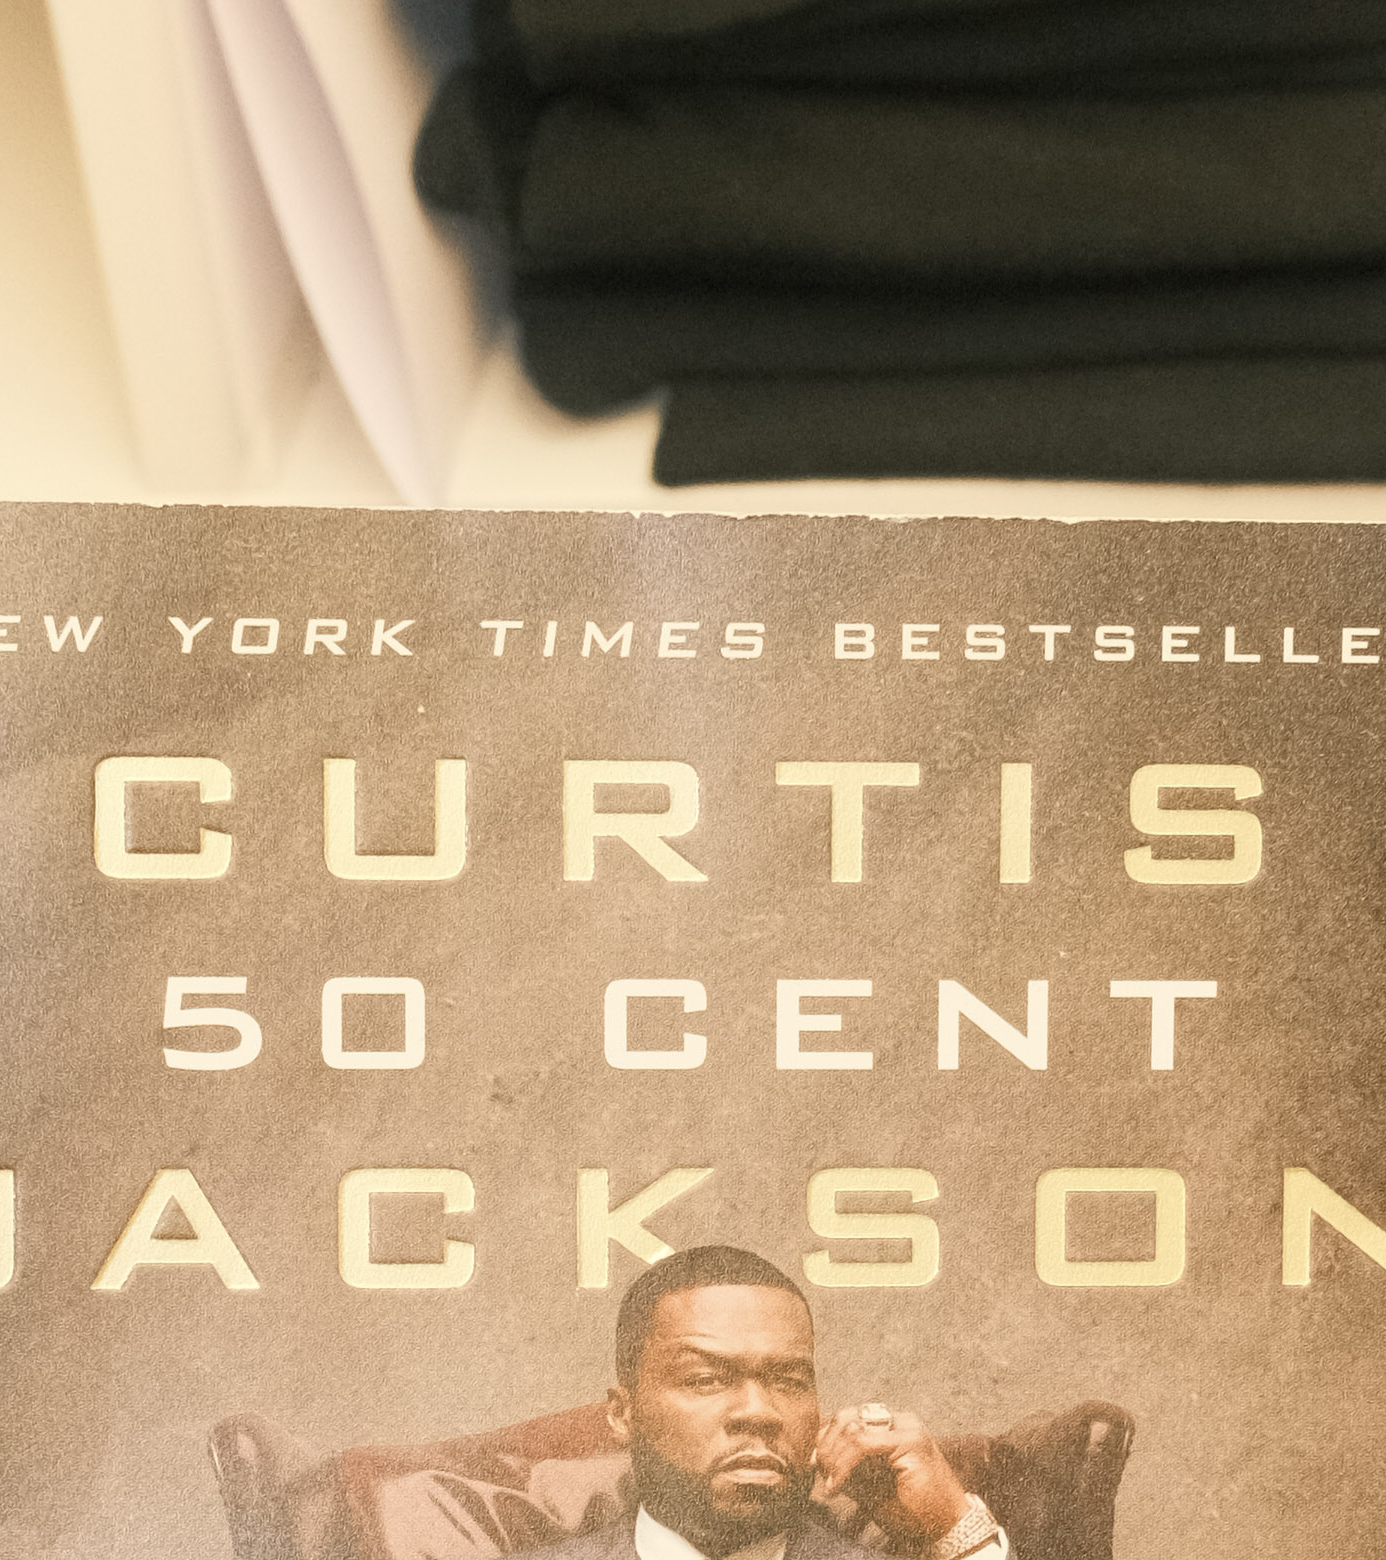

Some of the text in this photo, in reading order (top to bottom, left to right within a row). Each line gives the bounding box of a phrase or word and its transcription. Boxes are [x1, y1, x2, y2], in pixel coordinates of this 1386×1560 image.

[168, 616, 416, 657] YORK
[479, 619, 767, 660] TIMES
[92, 754, 1266, 888] CURTIS
[163, 976, 1219, 1071] 50 CENT
